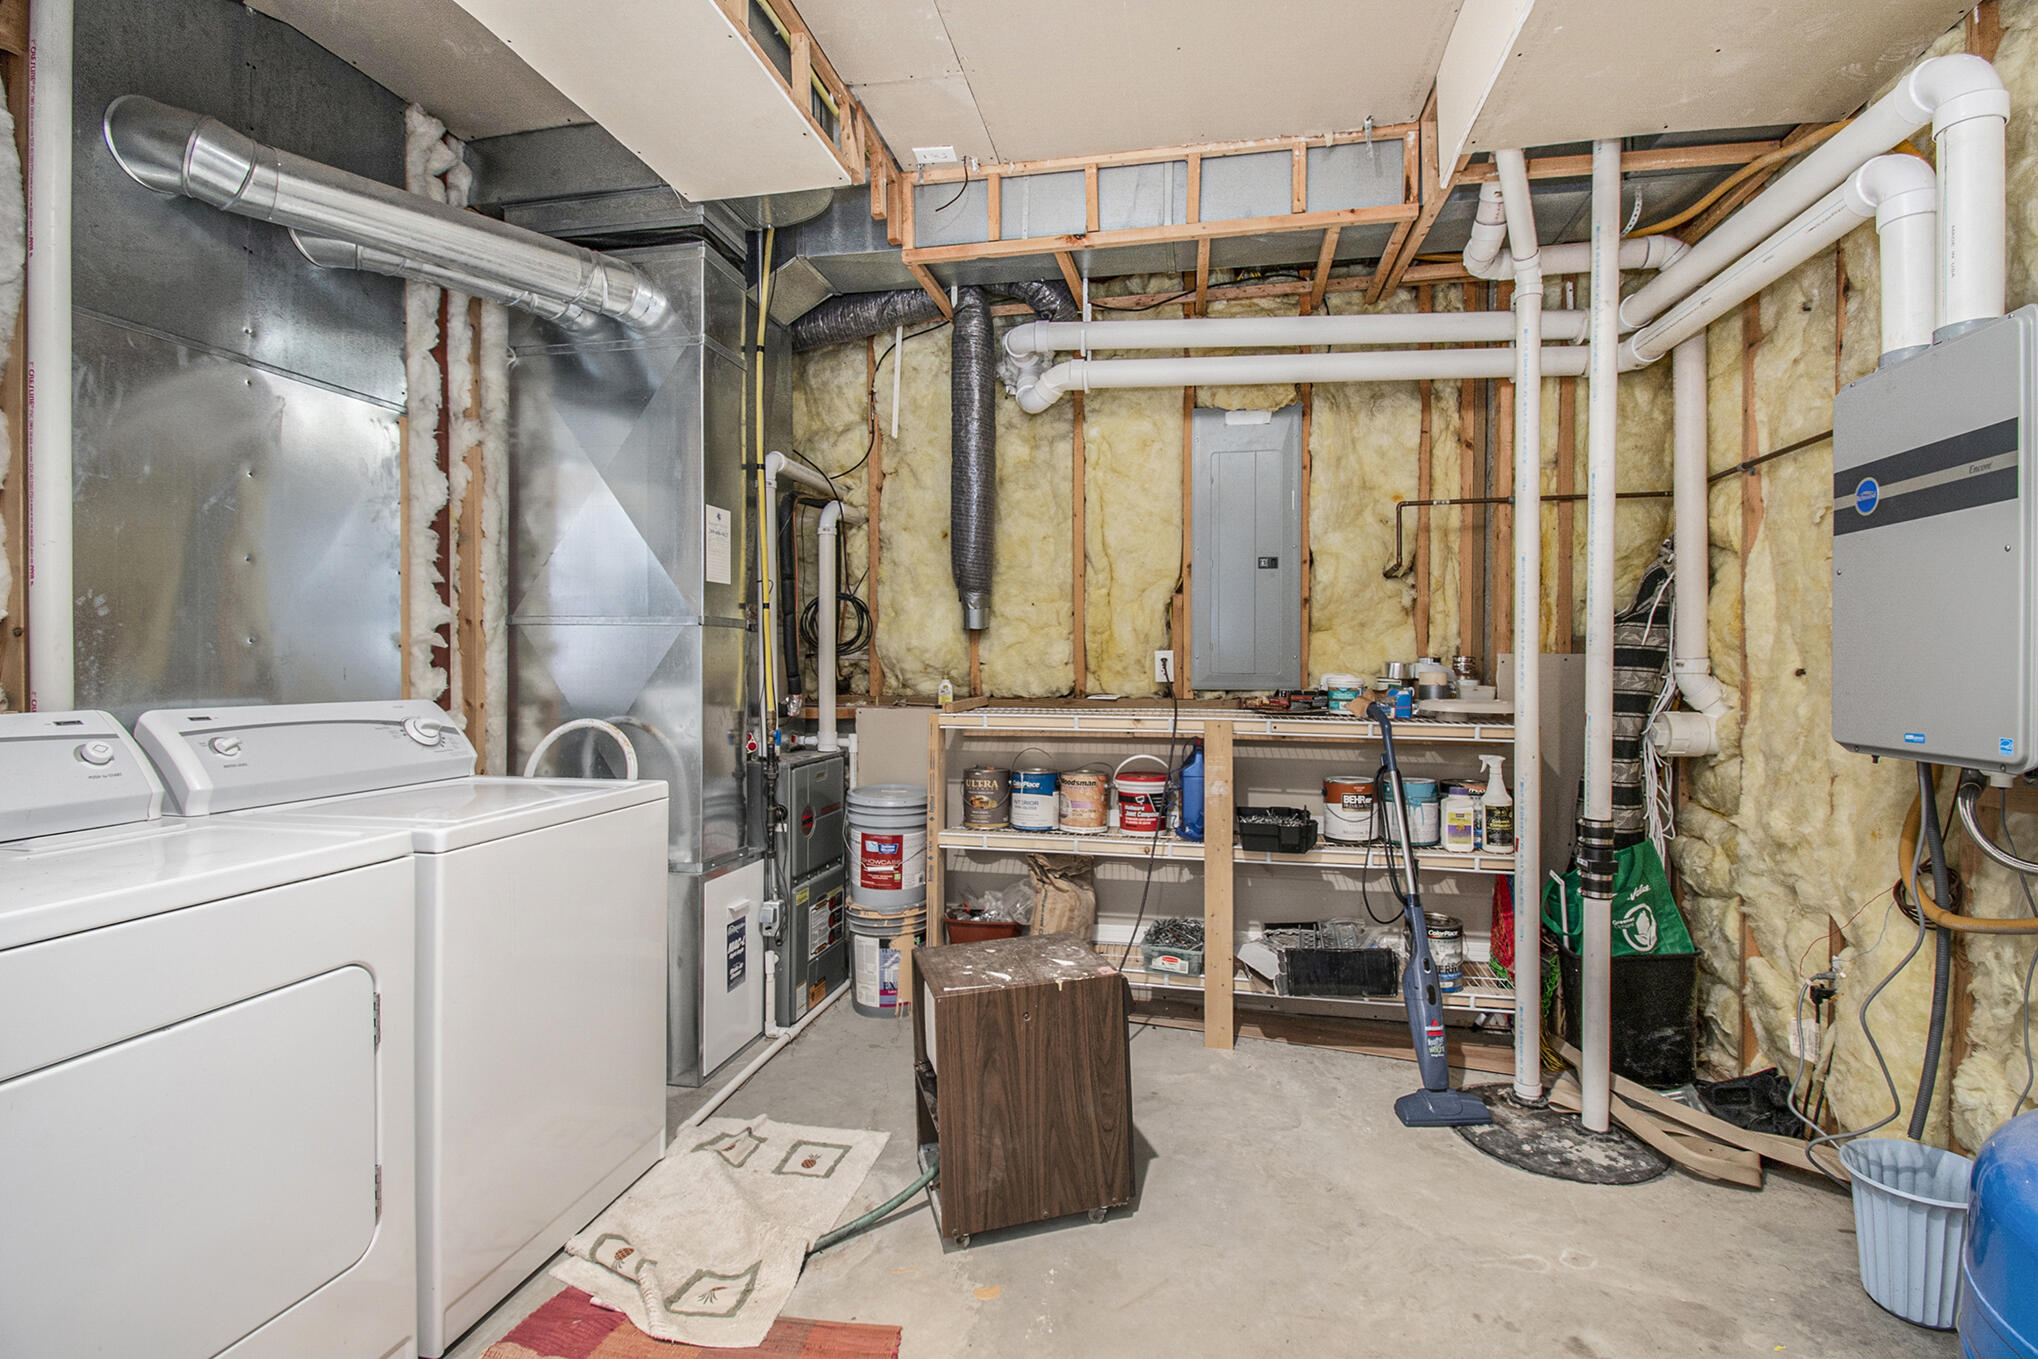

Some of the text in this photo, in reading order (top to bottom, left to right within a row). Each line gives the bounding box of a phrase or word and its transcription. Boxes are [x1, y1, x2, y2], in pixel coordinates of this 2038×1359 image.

[1968, 463, 1991, 474] Encore
[966, 779, 998, 788] ULTRA
[1343, 795, 1365, 803] BEHR
